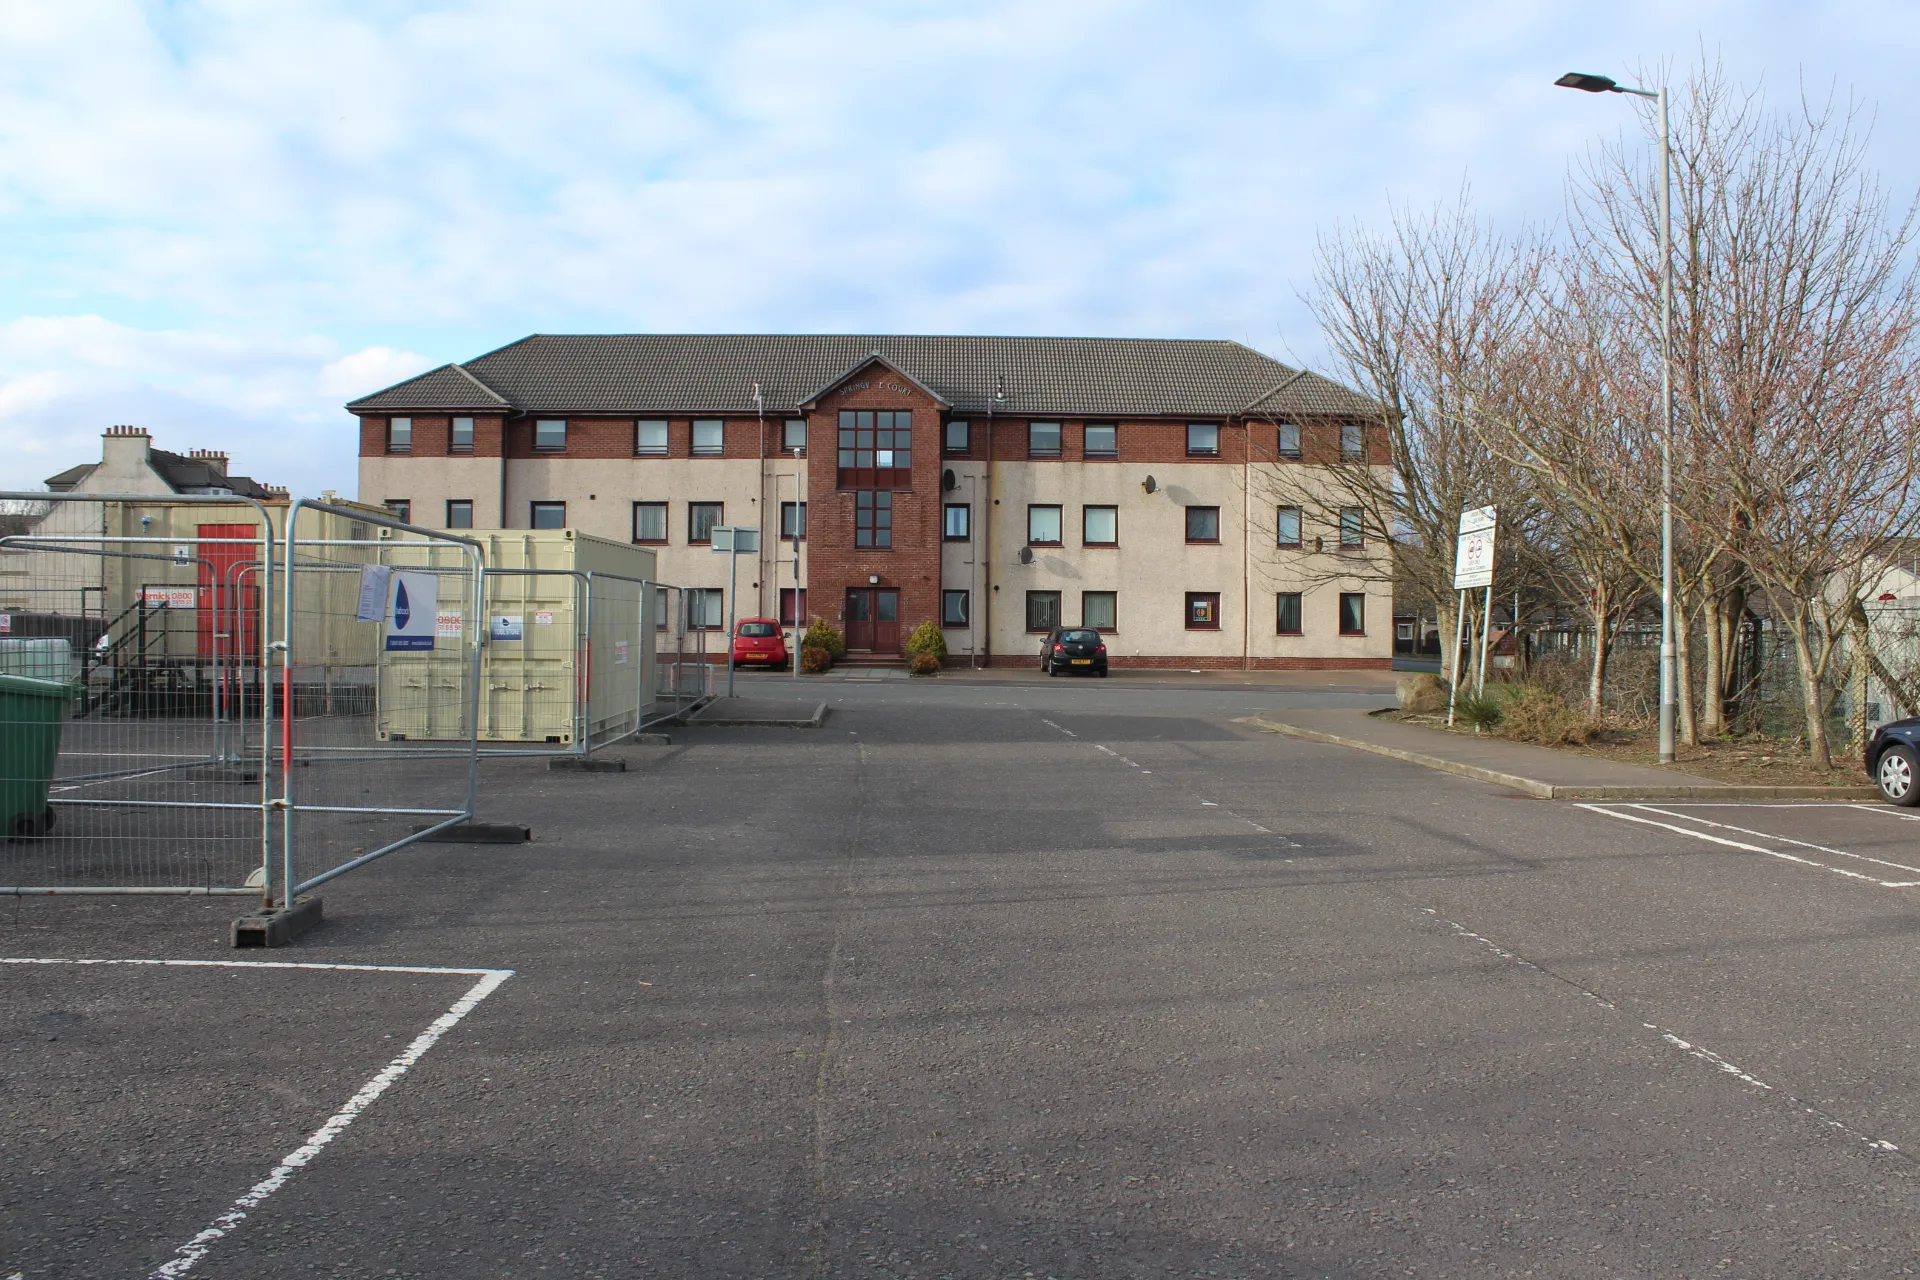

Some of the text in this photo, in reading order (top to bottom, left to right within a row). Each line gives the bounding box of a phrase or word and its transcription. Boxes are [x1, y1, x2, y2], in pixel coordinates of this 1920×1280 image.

[887, 383, 912, 396] COURT
[136, 592, 170, 600] Wernick
[494, 628, 521, 636] TOOL STORE
